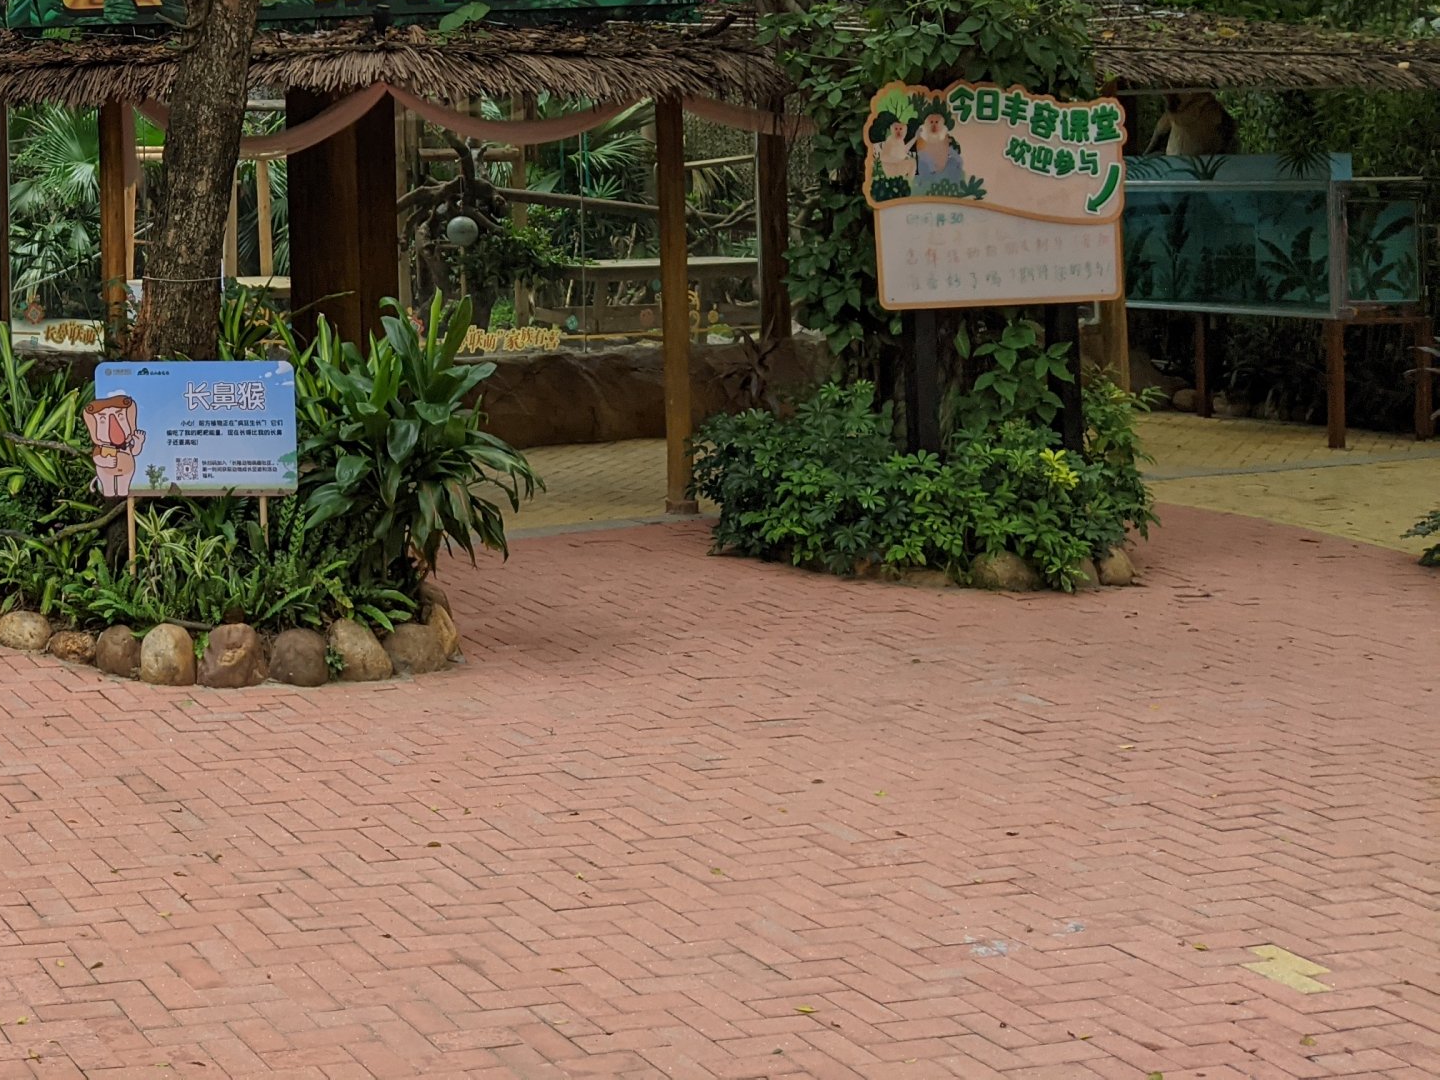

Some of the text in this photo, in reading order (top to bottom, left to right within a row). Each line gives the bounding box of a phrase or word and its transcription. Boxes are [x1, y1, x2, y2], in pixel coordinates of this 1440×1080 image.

[949, 86, 1121, 143] 今日丰容课堂
[1005, 137, 1100, 176] 欢迎参与
[183, 380, 266, 411] 长鼻猴
